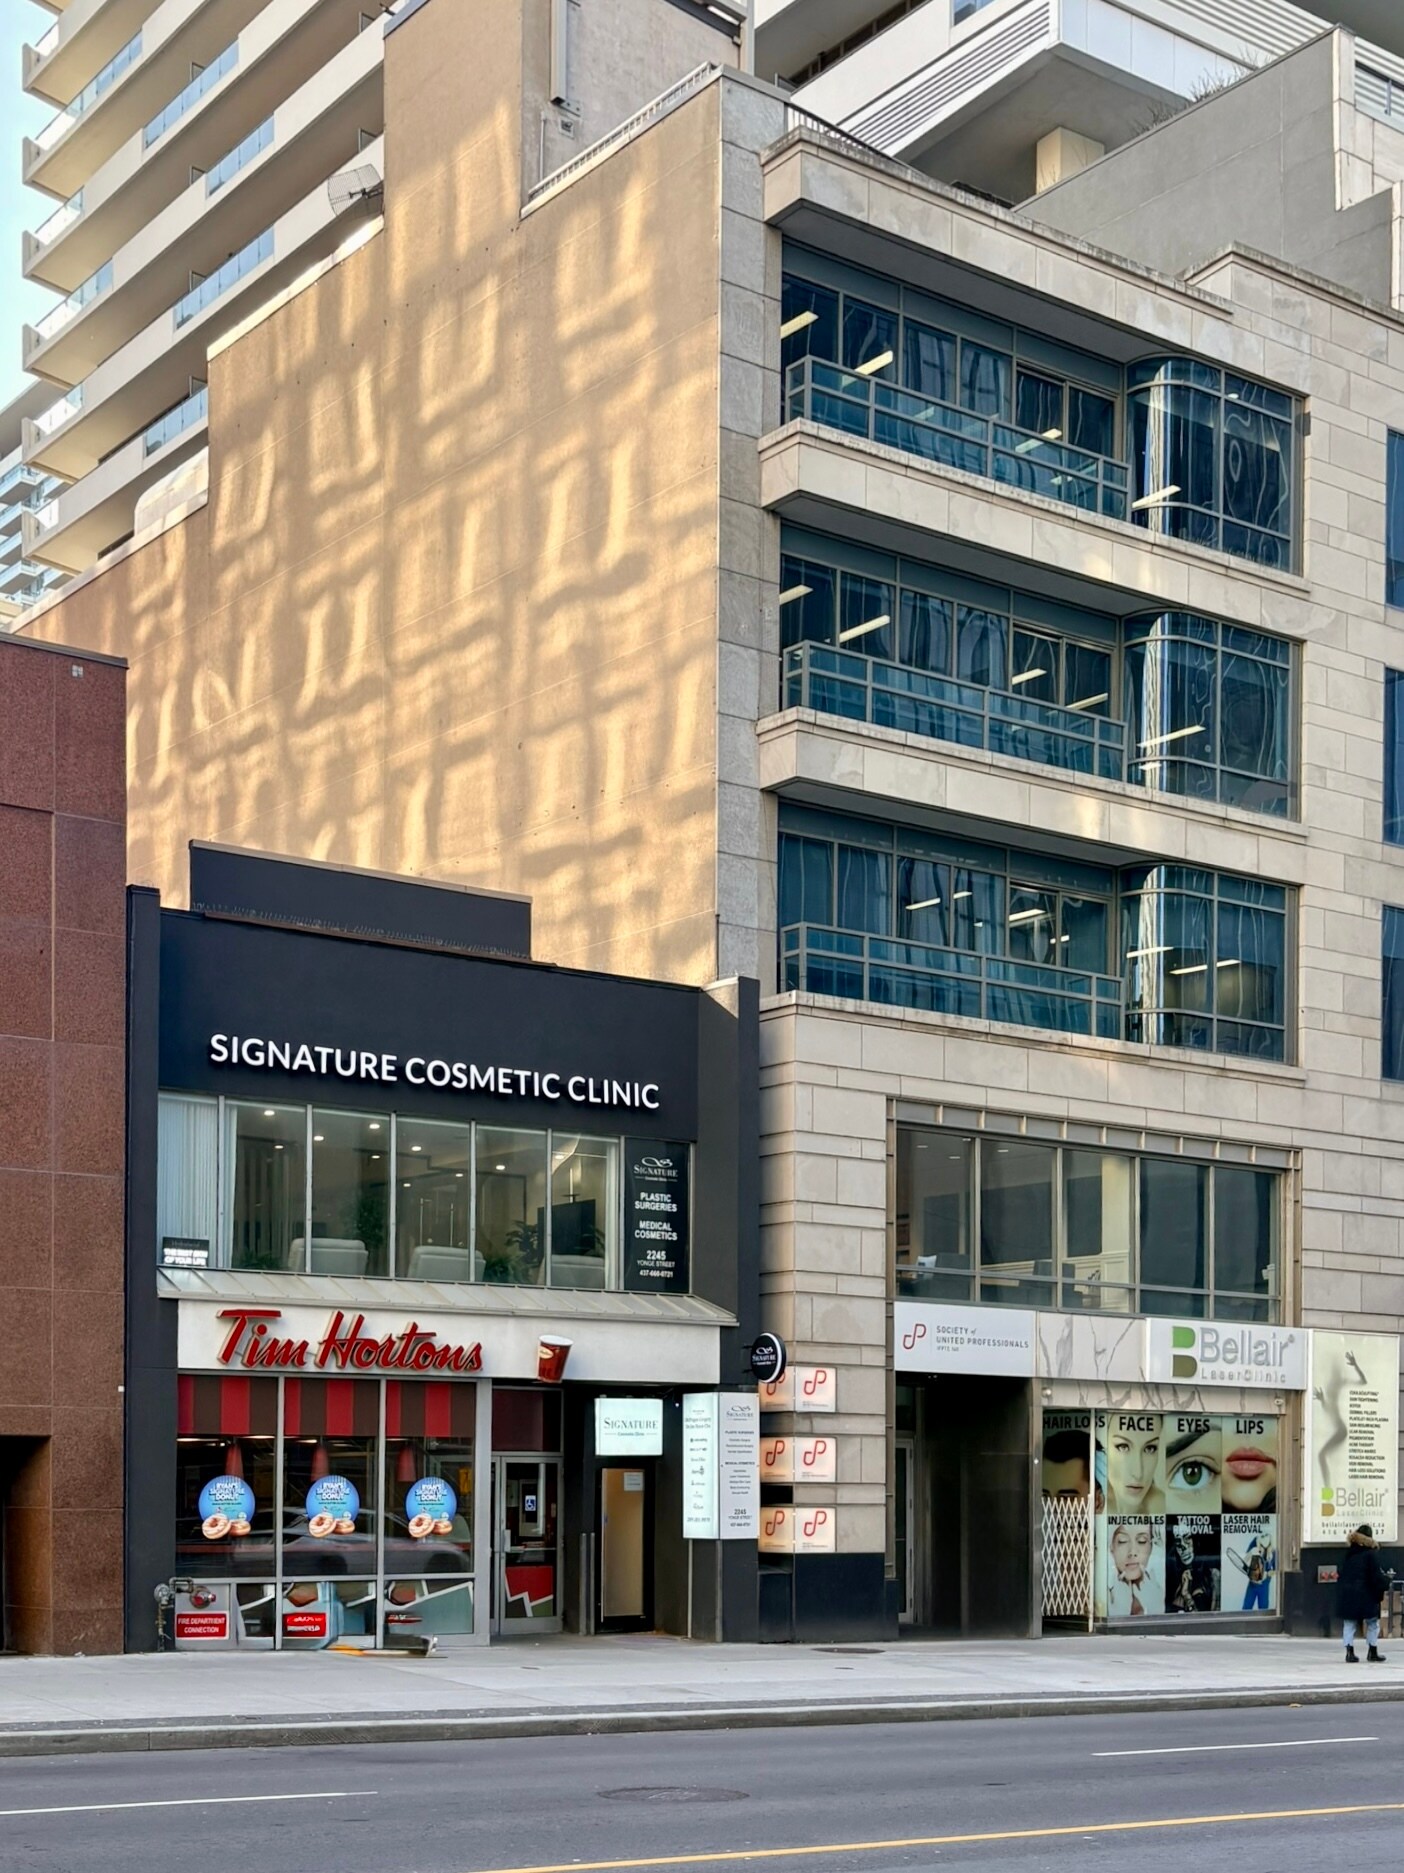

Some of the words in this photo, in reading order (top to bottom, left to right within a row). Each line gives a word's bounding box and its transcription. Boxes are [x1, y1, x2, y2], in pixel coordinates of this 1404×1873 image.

[210, 1034, 398, 1082] SIGNATURE
[405, 1057, 561, 1099] COSMETIC
[567, 1076, 660, 1109] CLINIC
[633, 1164, 678, 1177] SIGNATURE
[640, 1192, 672, 1202] PLASTIC
[634, 1200, 678, 1212] SURGERIES
[639, 1220, 672, 1231] MEDICAL
[634, 1230, 678, 1240] COSMETICS
[646, 1250, 666, 1260] 2245
[936, 1326, 968, 1334] SOCIETY
[970, 1328, 977, 1336] of
[216, 1309, 310, 1367] Tim
[314, 1310, 483, 1372] Hortons
[936, 1336, 965, 1345] UNITED
[967, 1338, 1029, 1348] PROFESSIONALS
[1200, 1327, 1288, 1367] Bellair
[603, 1417, 659, 1429] SIGNATURE
[1043, 1416, 1072, 1428] HAIR
[1119, 1416, 1154, 1432] FACE
[1177, 1418, 1210, 1433] EYES
[1236, 1420, 1264, 1434] LIPS
[1336, 1488, 1385, 1507] Bellair
[1108, 1516, 1165, 1525] INJECTABLES
[1177, 1515, 1210, 1525] TATTOO
[1223, 1516, 1248, 1524] LASER
[1250, 1516, 1270, 1524] HAIR
[1223, 1524, 1263, 1534] REMOVAL
